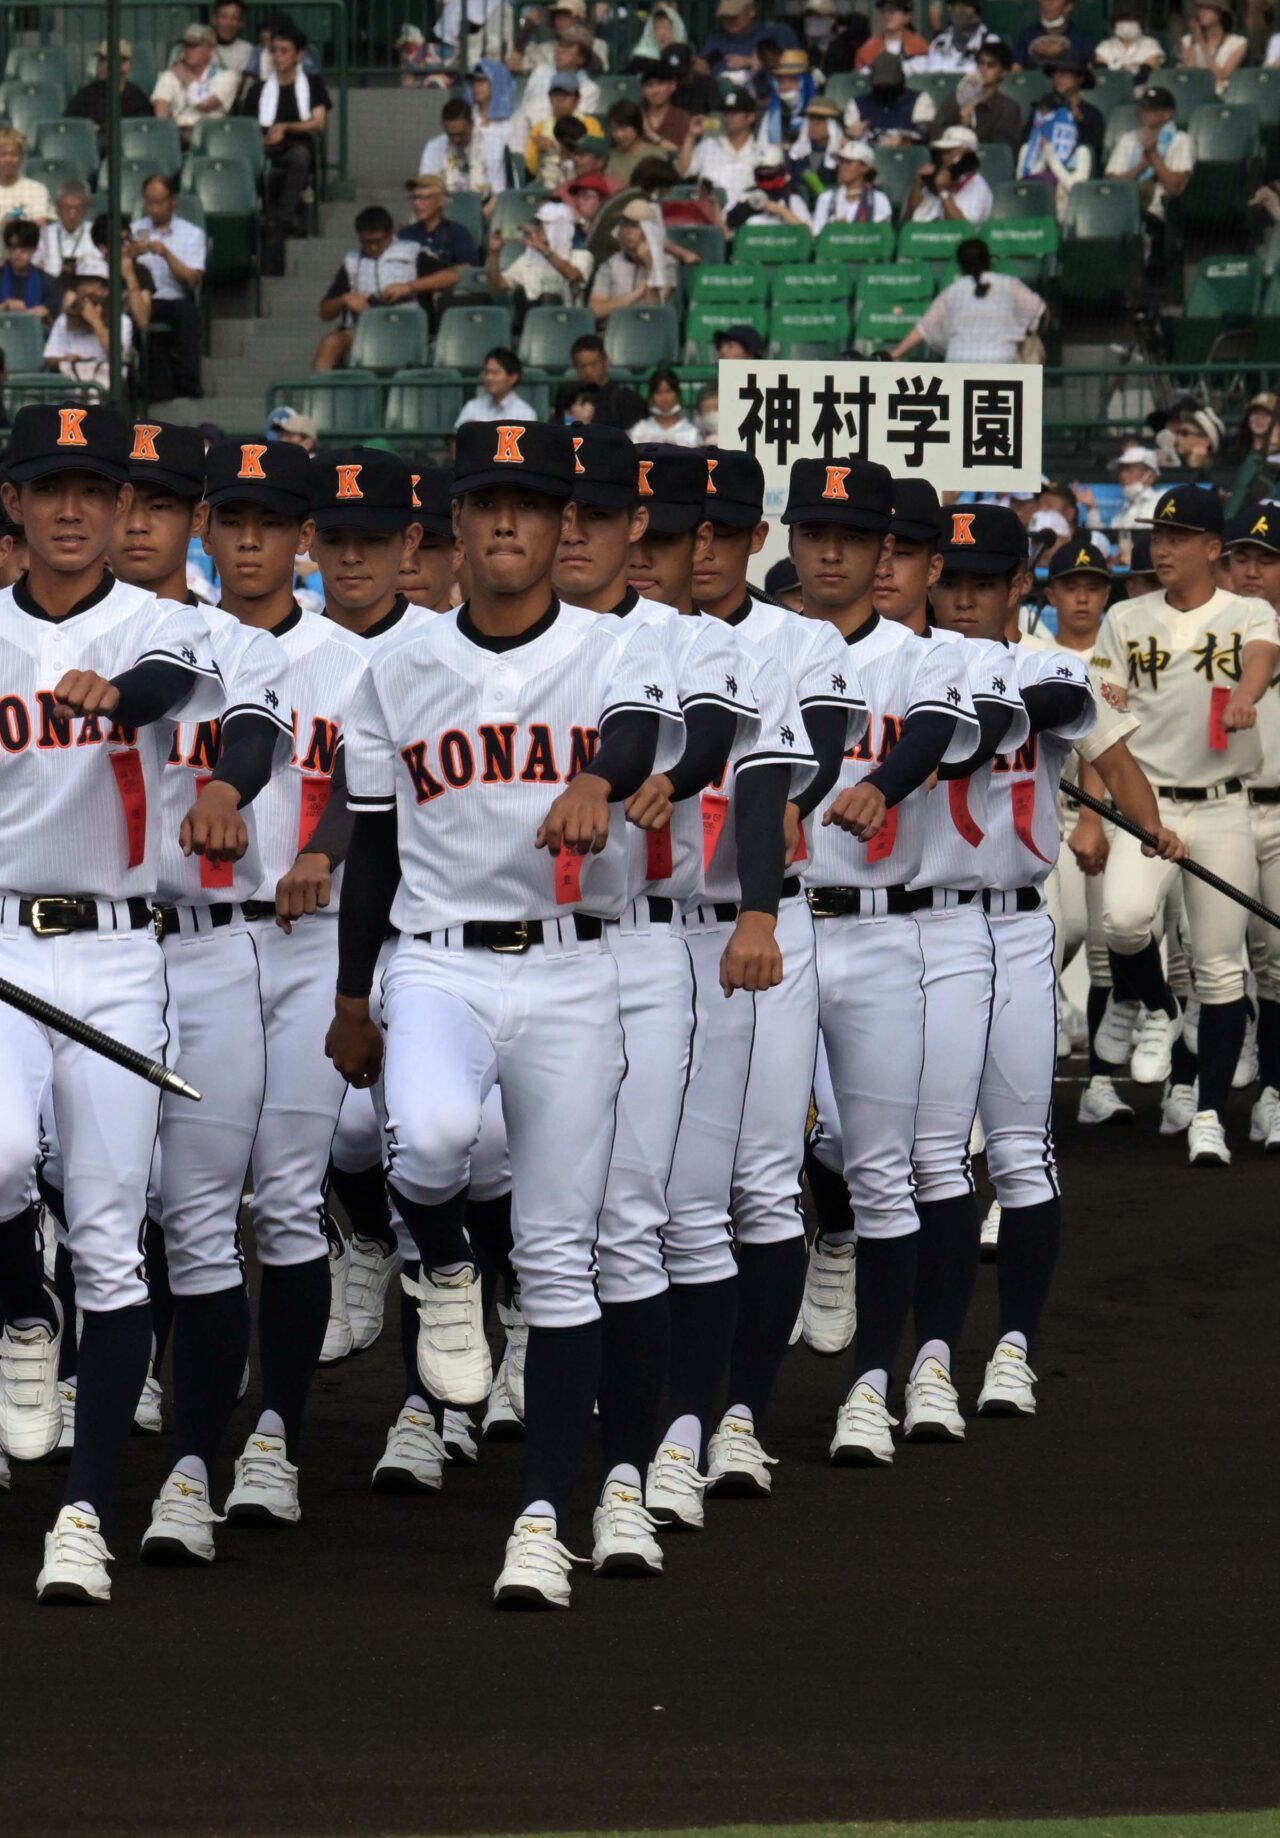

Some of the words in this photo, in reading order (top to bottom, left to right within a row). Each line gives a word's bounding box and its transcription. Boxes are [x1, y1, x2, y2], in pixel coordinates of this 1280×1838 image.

[58, 409, 88, 446] K
[738, 373, 1024, 470] 神村学園
[130, 425, 161, 461] K
[494, 426, 526, 463] K
[238, 444, 267, 479] K
[336, 465, 365, 500] K
[822, 465, 851, 500] K
[950, 513, 977, 545] K
[1127, 630, 1244, 692] 神村
[401, 721, 601, 806] KONAN
